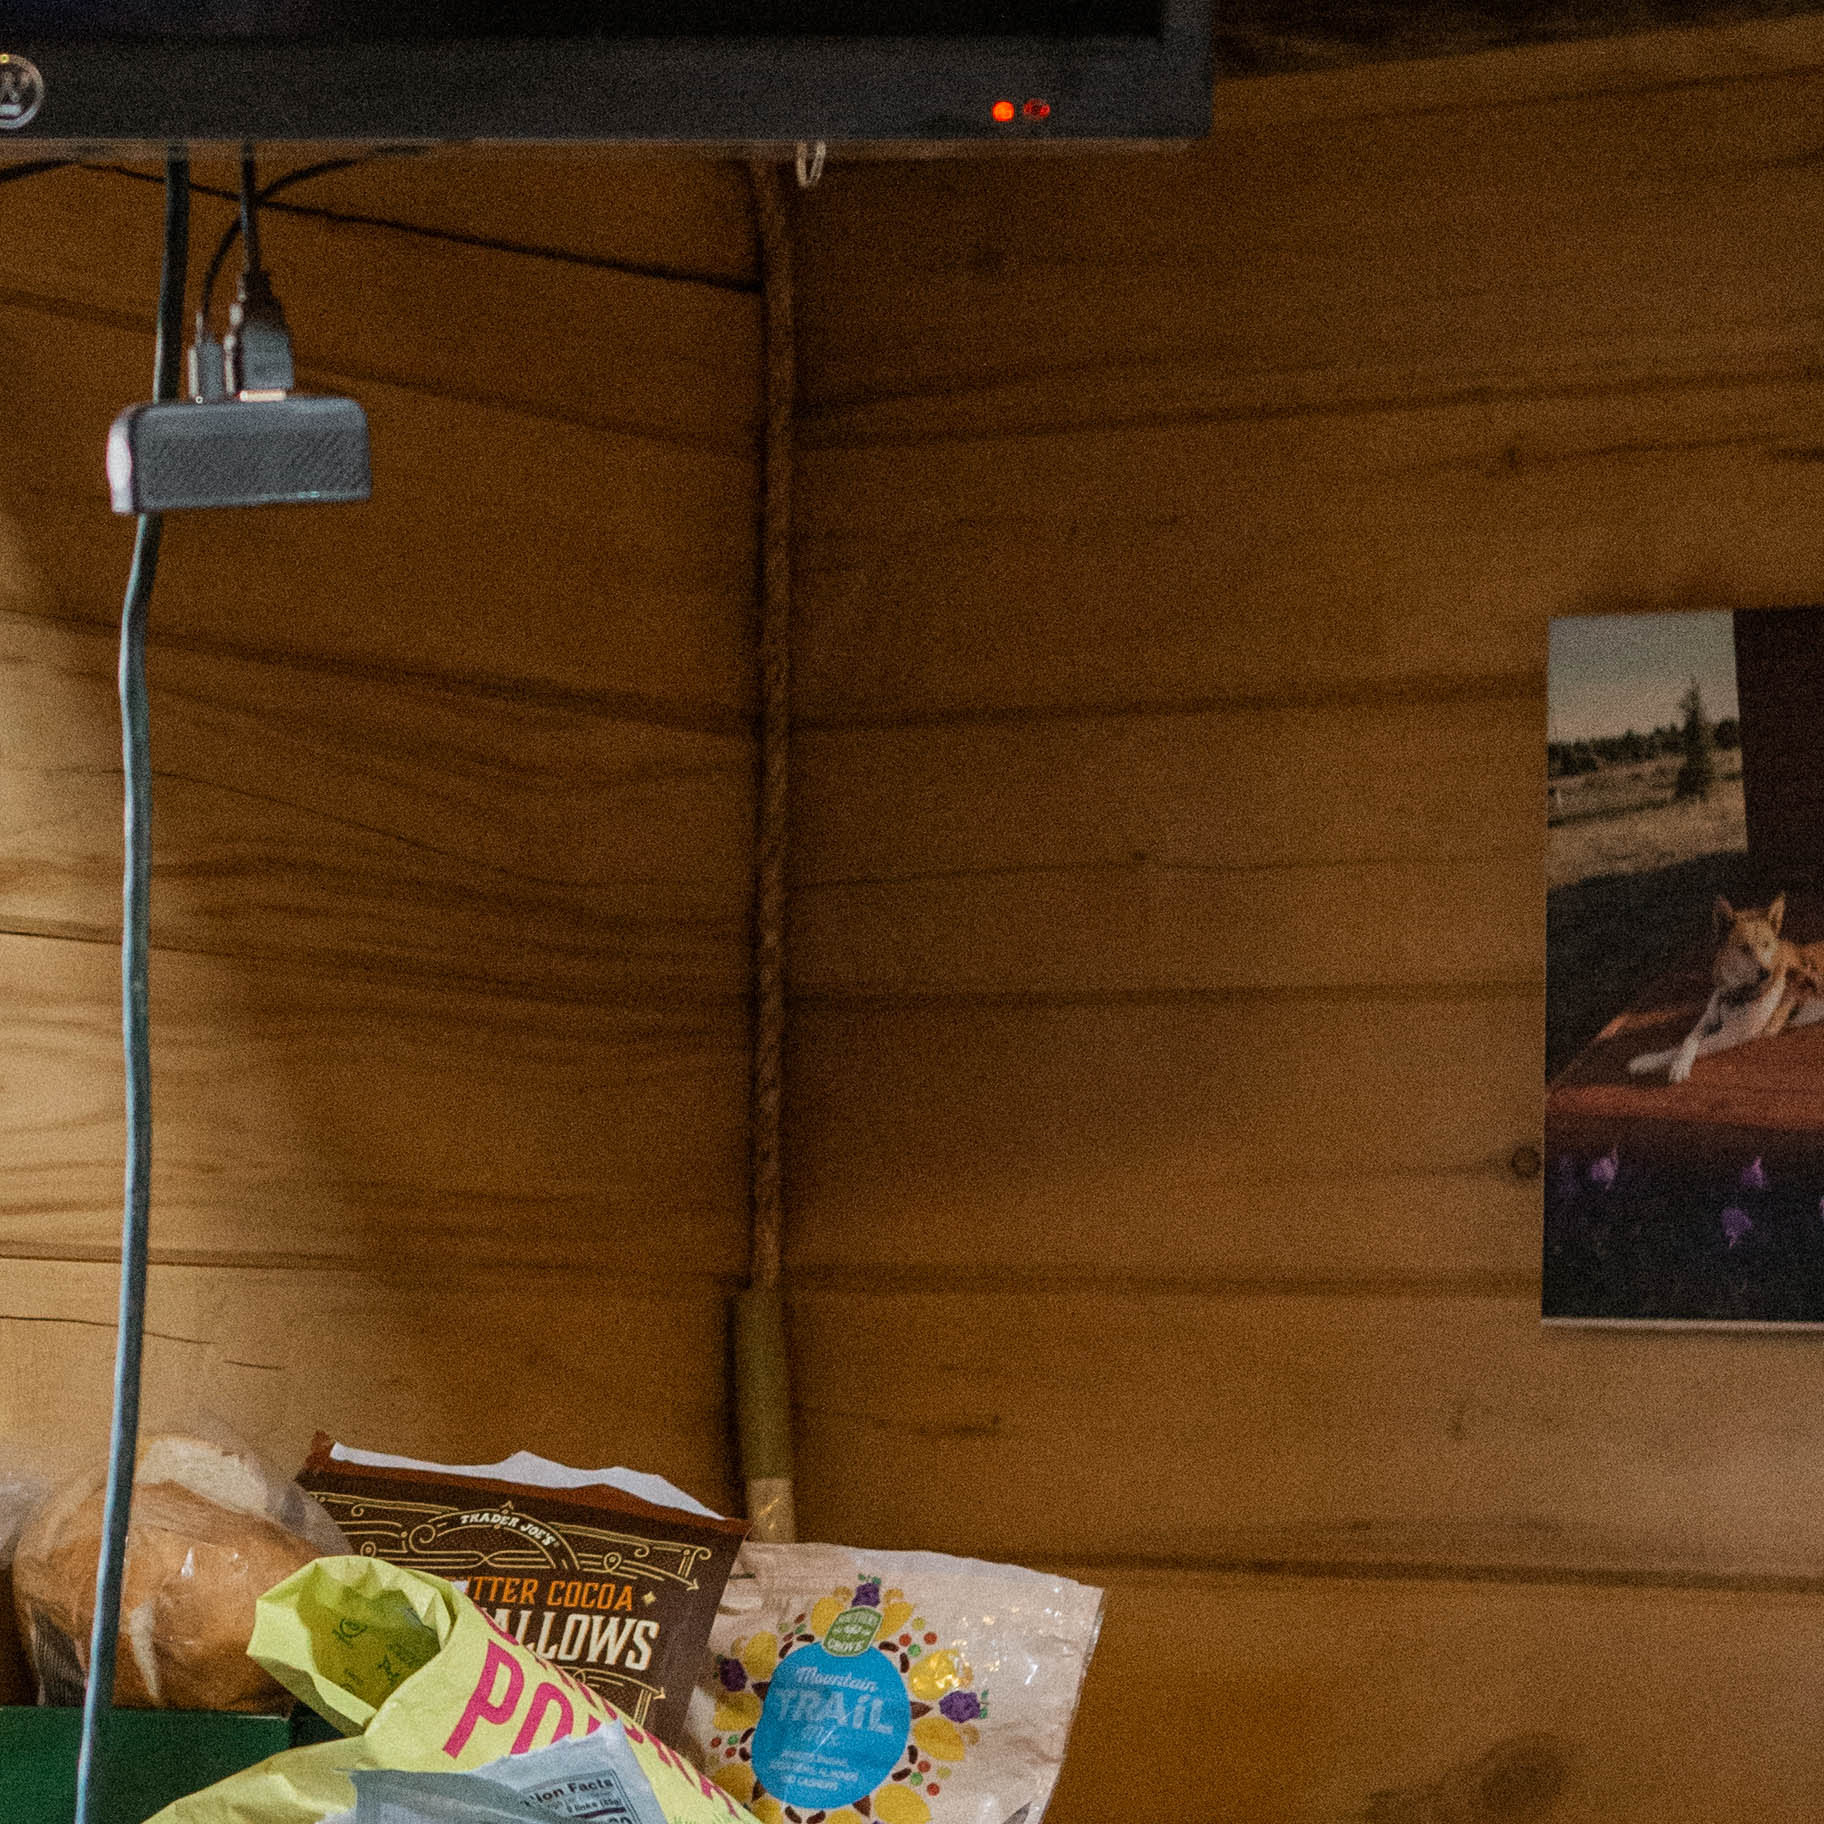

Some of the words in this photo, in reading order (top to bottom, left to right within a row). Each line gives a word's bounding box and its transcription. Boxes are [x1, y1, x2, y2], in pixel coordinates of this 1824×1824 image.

[460, 1512, 520, 1528] TRADER
[520, 1523, 557, 1546] JOE'S
[546, 1579, 634, 1612] COCOA
[795, 1665, 878, 1692] Mountain
[567, 1778, 614, 1793] Facts
